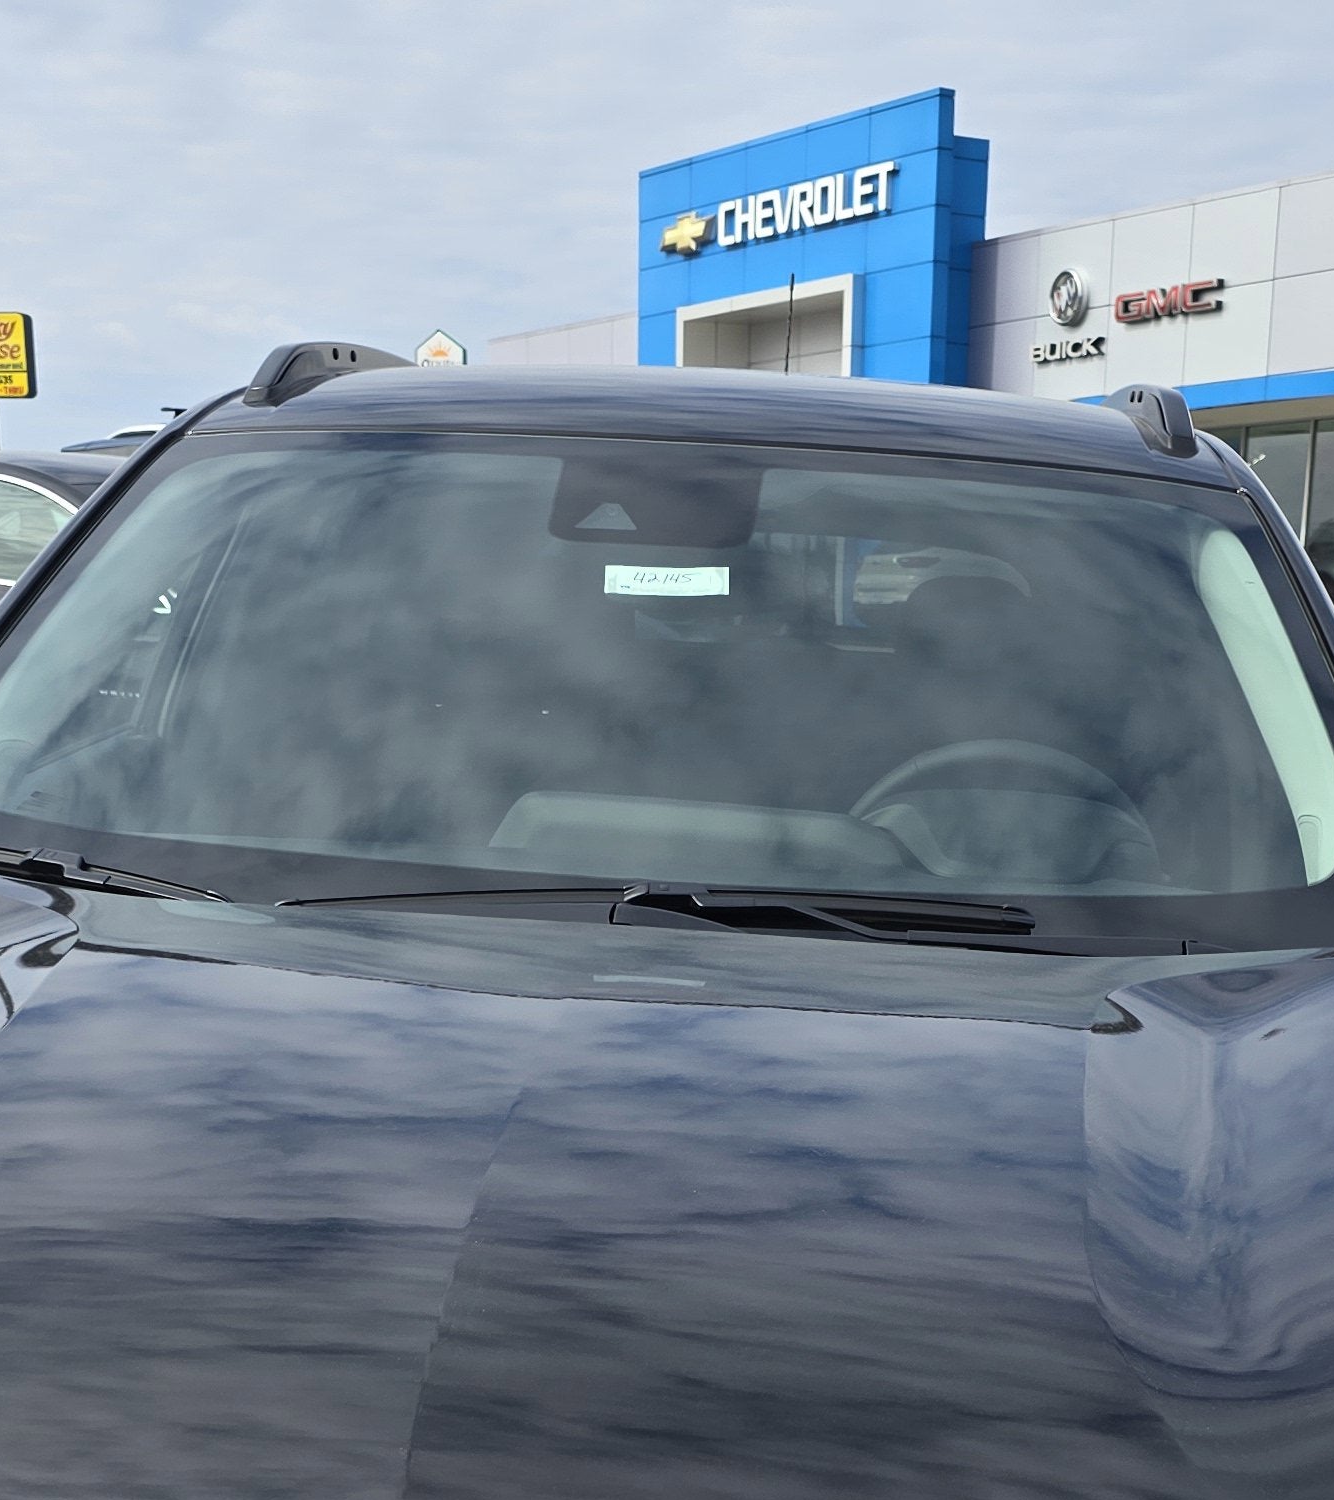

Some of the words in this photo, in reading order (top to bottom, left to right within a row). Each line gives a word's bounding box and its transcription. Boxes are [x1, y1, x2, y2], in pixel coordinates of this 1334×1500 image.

[718, 161, 897, 247] CHEVROLET
[1115, 279, 1224, 323] GMC
[1031, 337, 1105, 363] BUICK
